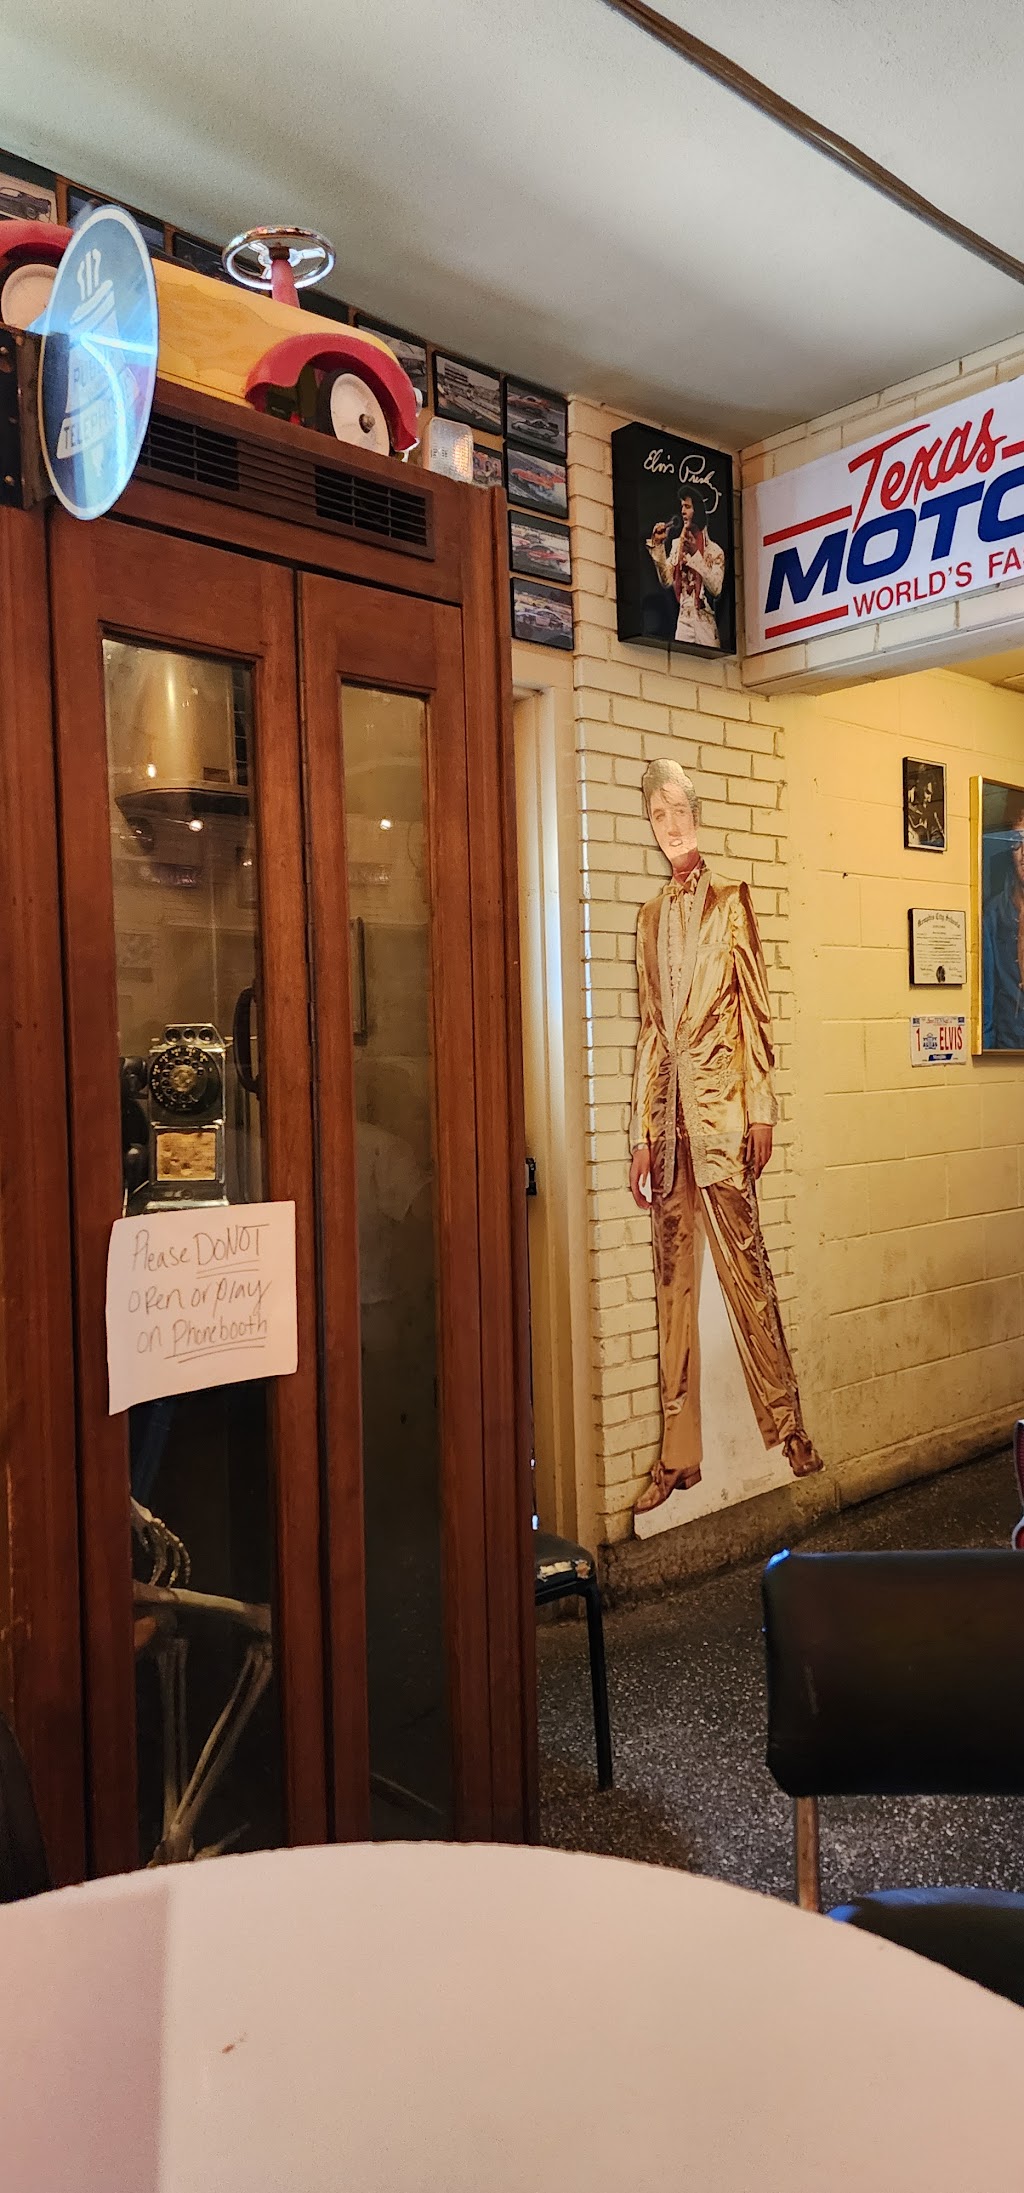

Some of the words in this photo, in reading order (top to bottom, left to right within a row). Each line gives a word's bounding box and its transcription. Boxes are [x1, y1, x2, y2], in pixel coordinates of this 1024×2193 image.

[643, 448, 675, 474] Elvis
[848, 408, 1008, 533] Texas
[852, 561, 973, 617] WORLD'S
[989, 546, 1024, 579] FA
[916, 1027, 921, 1052] 1
[939, 1026, 963, 1051] ELVIS
[131, 1229, 191, 1272] Please
[190, 1283, 213, 1308] or
[136, 1325, 162, 1354] on
